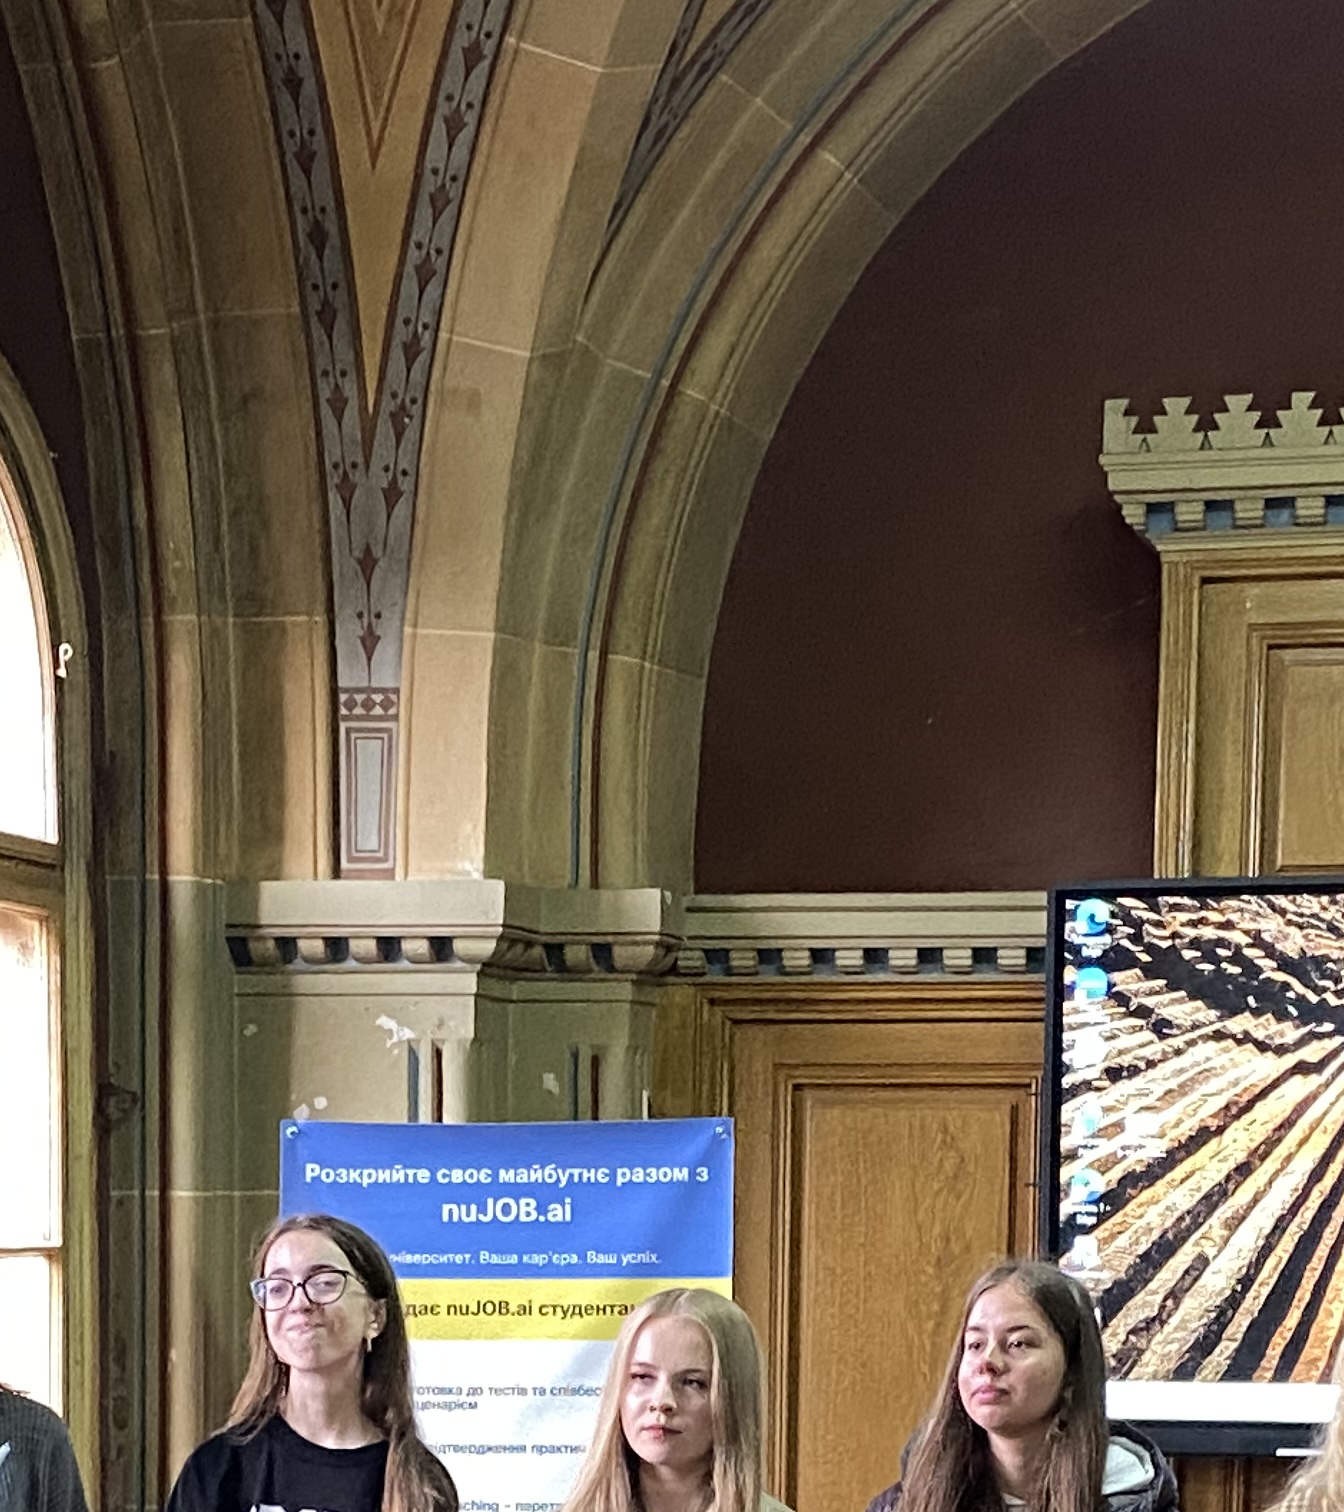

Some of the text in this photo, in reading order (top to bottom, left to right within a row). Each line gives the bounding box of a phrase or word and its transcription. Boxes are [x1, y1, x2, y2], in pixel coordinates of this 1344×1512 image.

[305, 1162, 709, 1188] Розкрийте своє майбутнє разом з
[441, 1196, 572, 1223] nuJOB.ai
[479, 1250, 519, 1265] Ваша
[586, 1250, 617, 1264] Ваш
[446, 1299, 533, 1317] nuJOB.ai
[466, 1386, 485, 1397] до
[488, 1384, 529, 1397] тестів
[531, 1386, 547, 1397] та
